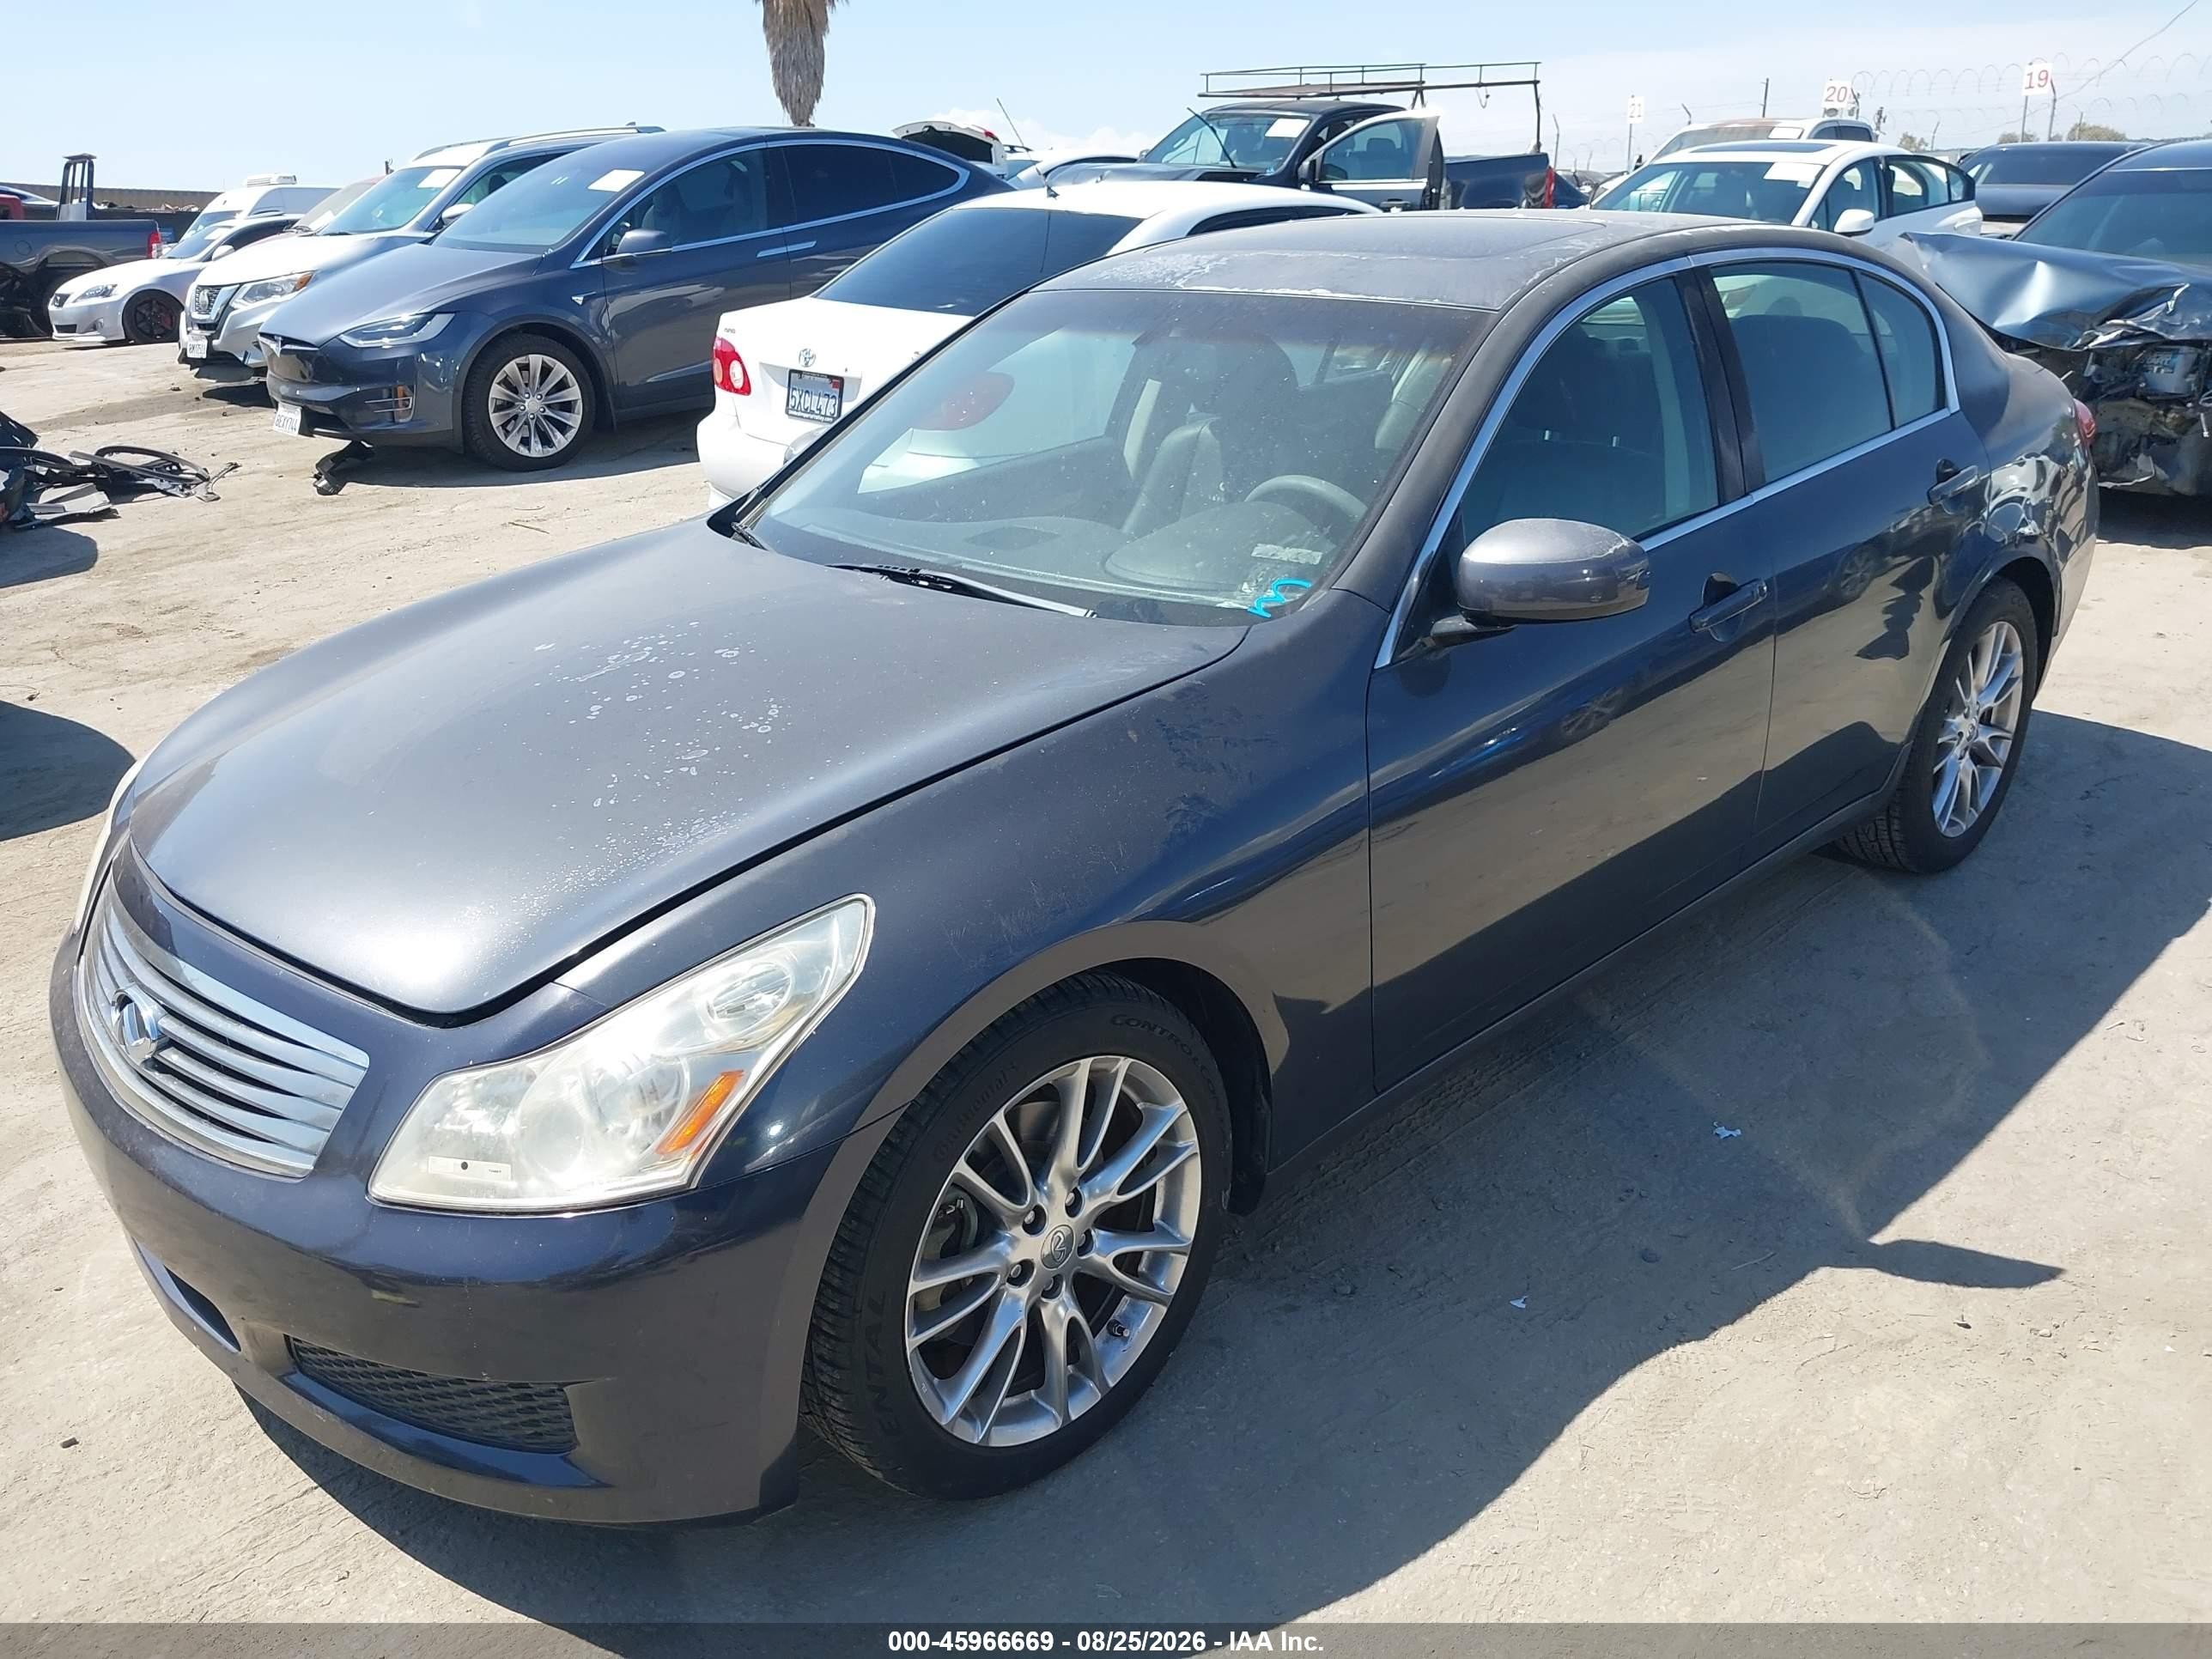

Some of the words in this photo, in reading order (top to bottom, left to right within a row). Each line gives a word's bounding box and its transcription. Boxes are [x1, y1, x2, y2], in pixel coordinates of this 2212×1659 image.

[2025, 70, 2049, 89] 19
[1825, 86, 1848, 103] 20
[1628, 102, 1643, 118] 21
[791, 387, 837, 416] 5XCL473
[864, 1294, 901, 1435] ENTAL
